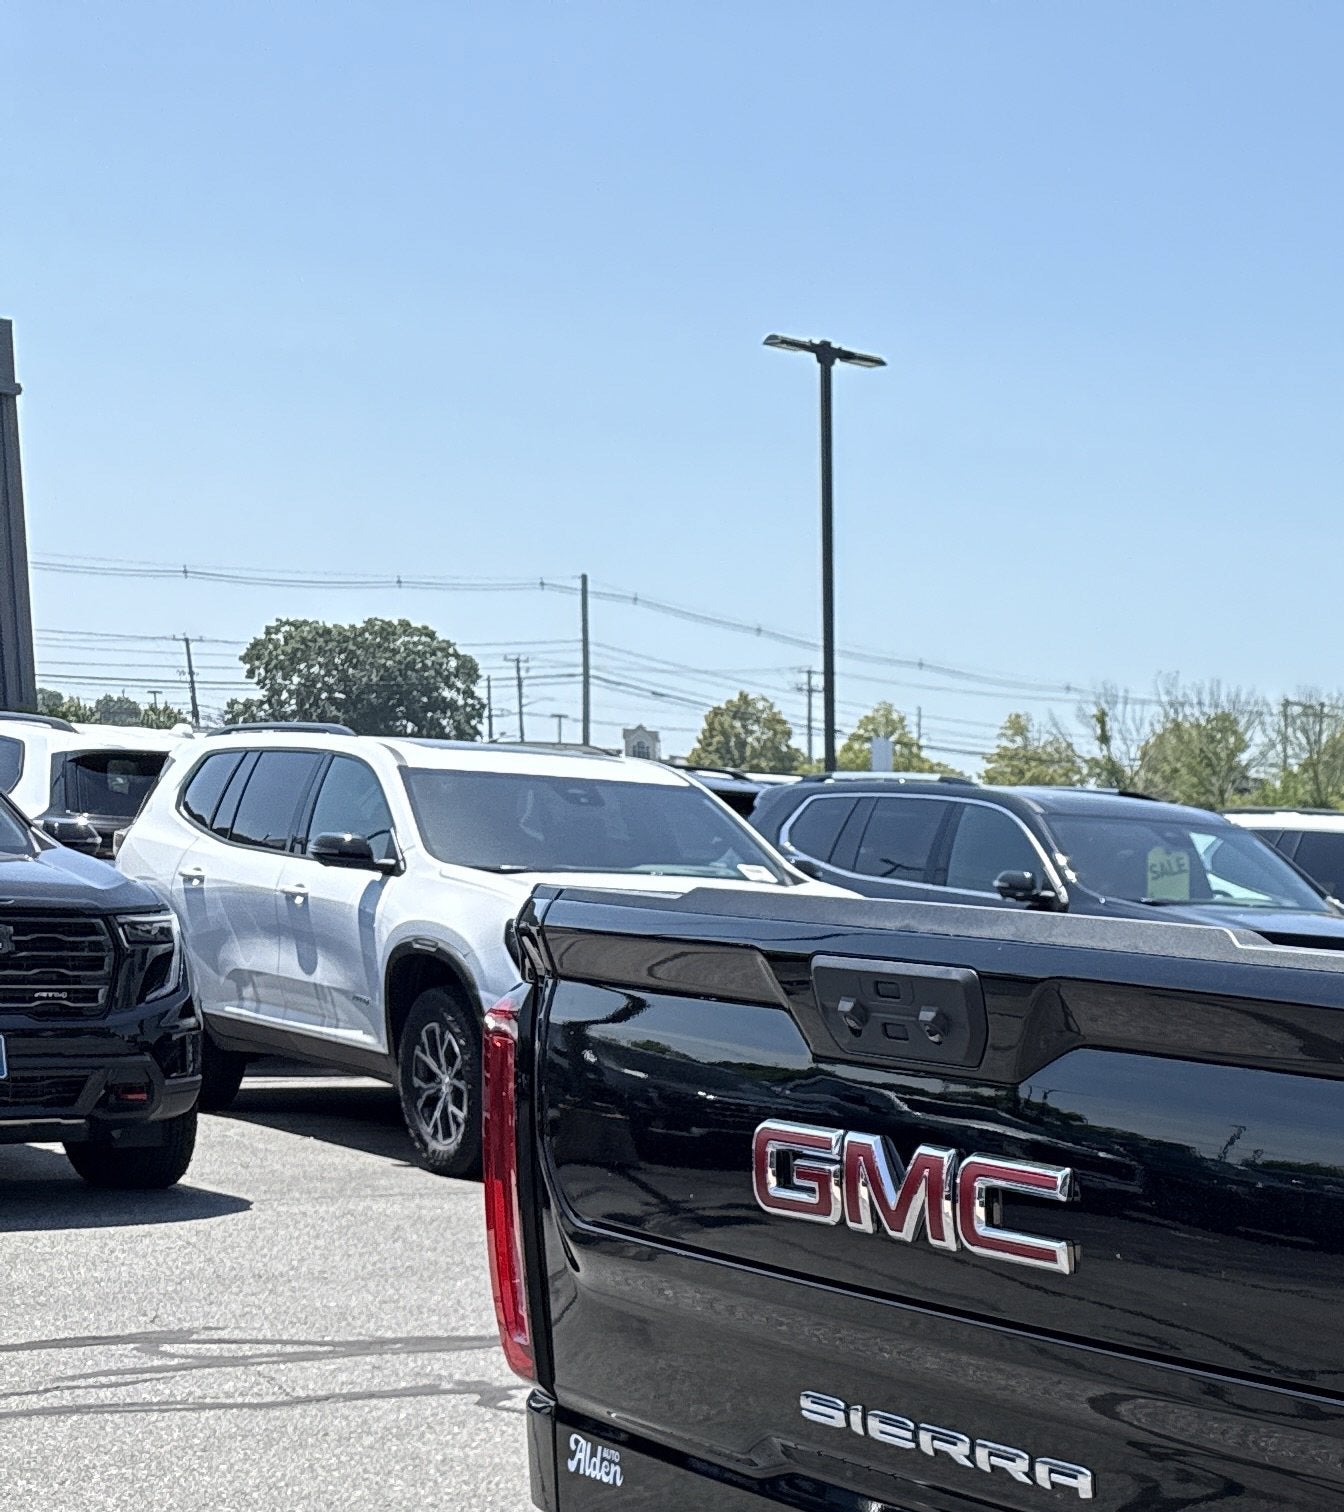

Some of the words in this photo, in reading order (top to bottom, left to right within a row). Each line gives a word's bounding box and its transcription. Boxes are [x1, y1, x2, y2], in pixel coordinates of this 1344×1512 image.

[1150, 856, 1188, 881] SALE
[753, 1118, 1081, 1275] GMC
[567, 1433, 624, 1487] Alden
[602, 1447, 621, 1462] AUTO
[800, 1390, 1096, 1500] SIERRA
